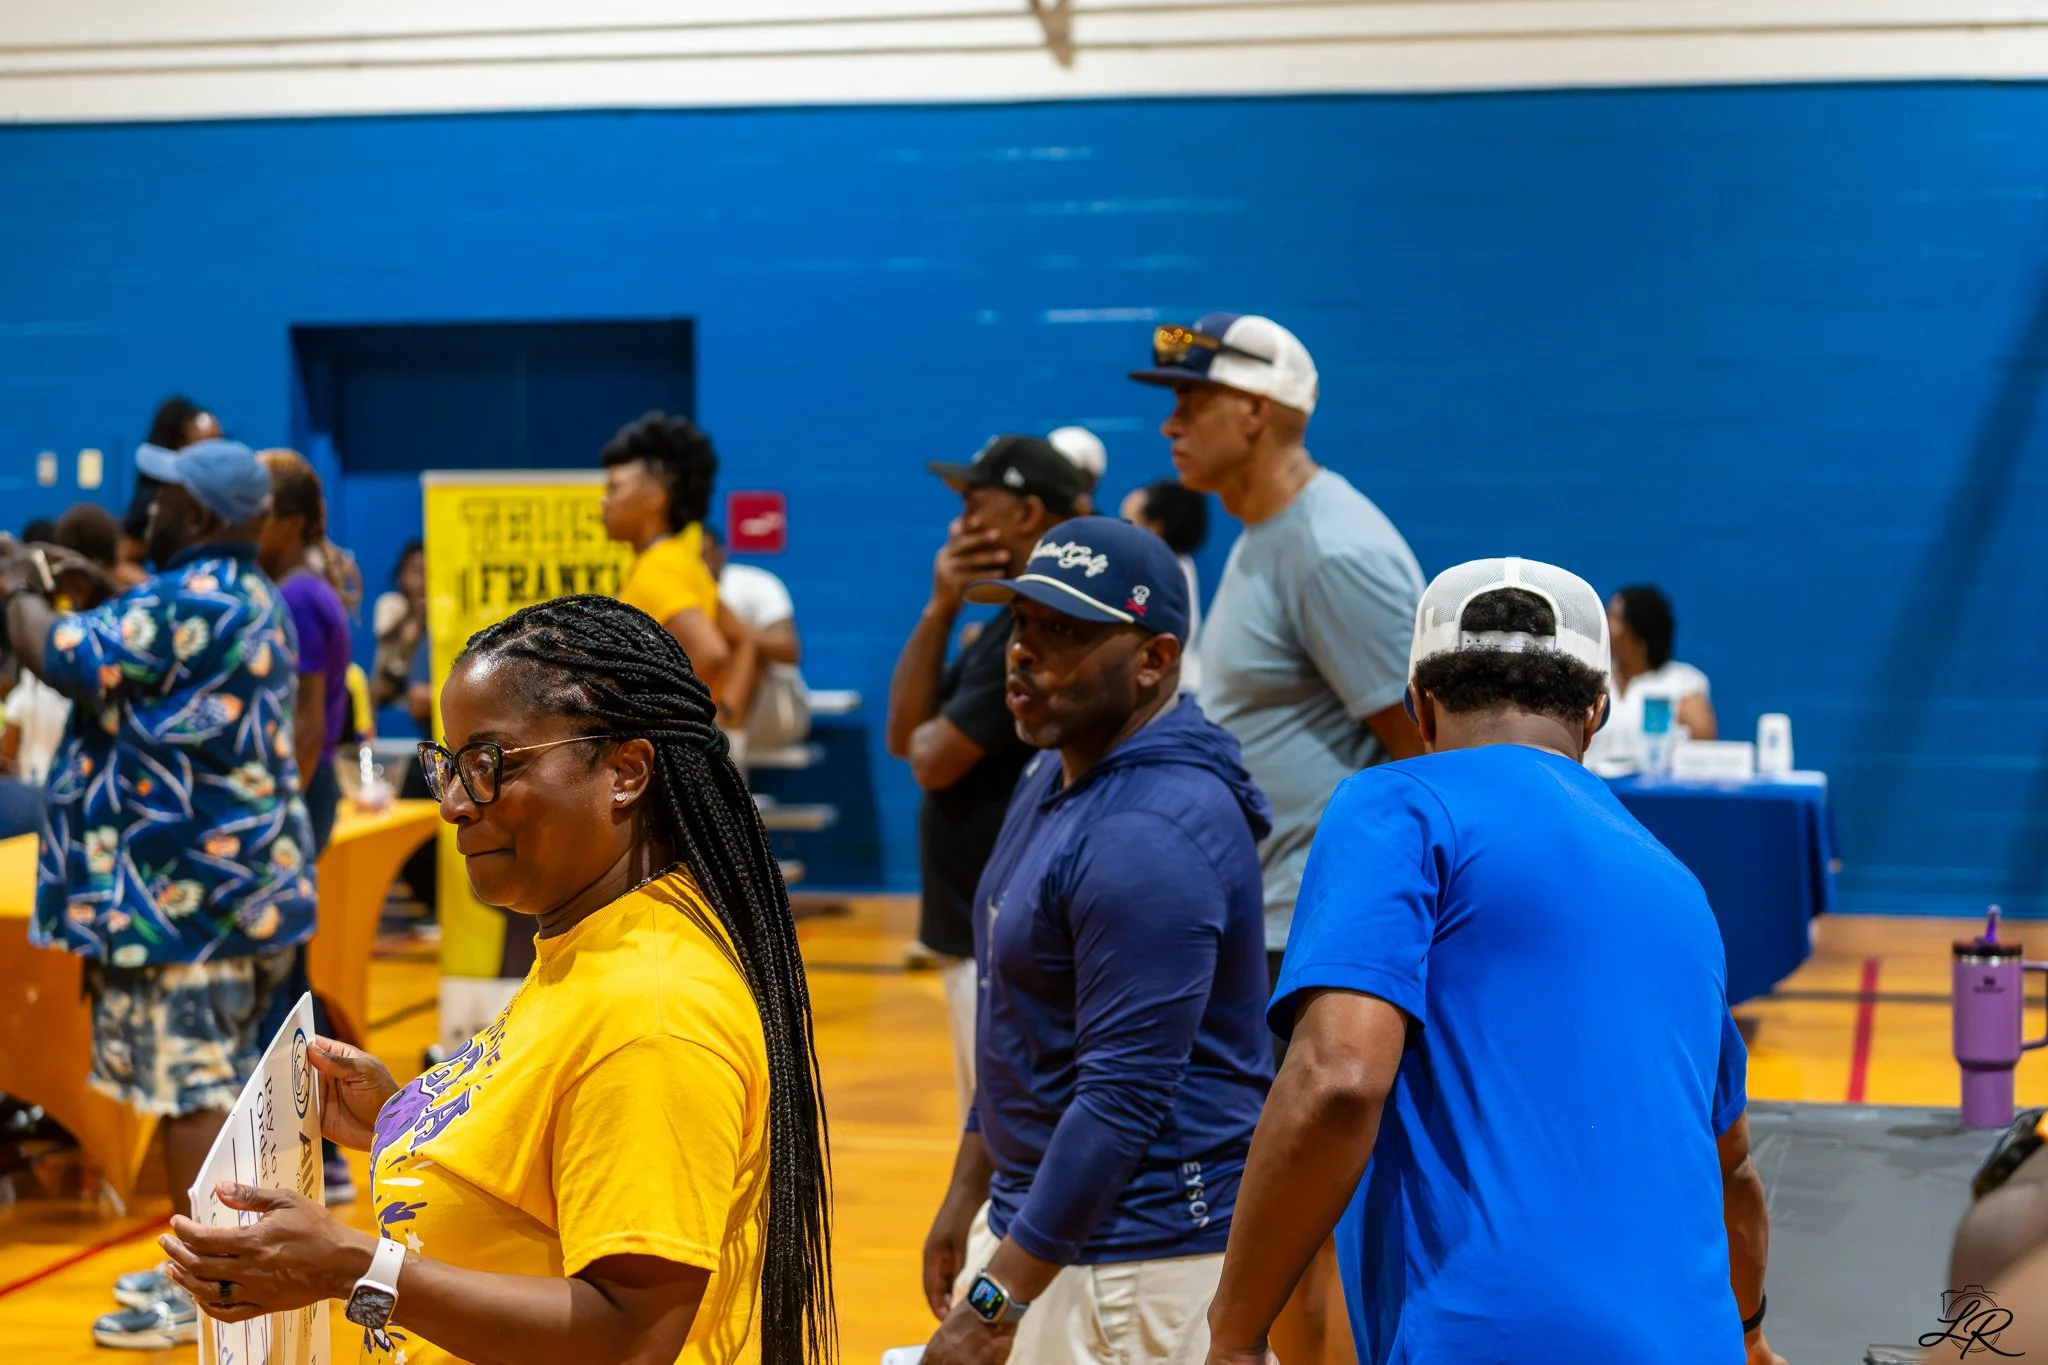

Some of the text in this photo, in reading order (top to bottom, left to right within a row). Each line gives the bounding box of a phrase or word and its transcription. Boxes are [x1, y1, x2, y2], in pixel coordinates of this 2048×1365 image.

[257, 1091, 269, 1181] Order
[265, 1075, 277, 1174] Pay to
